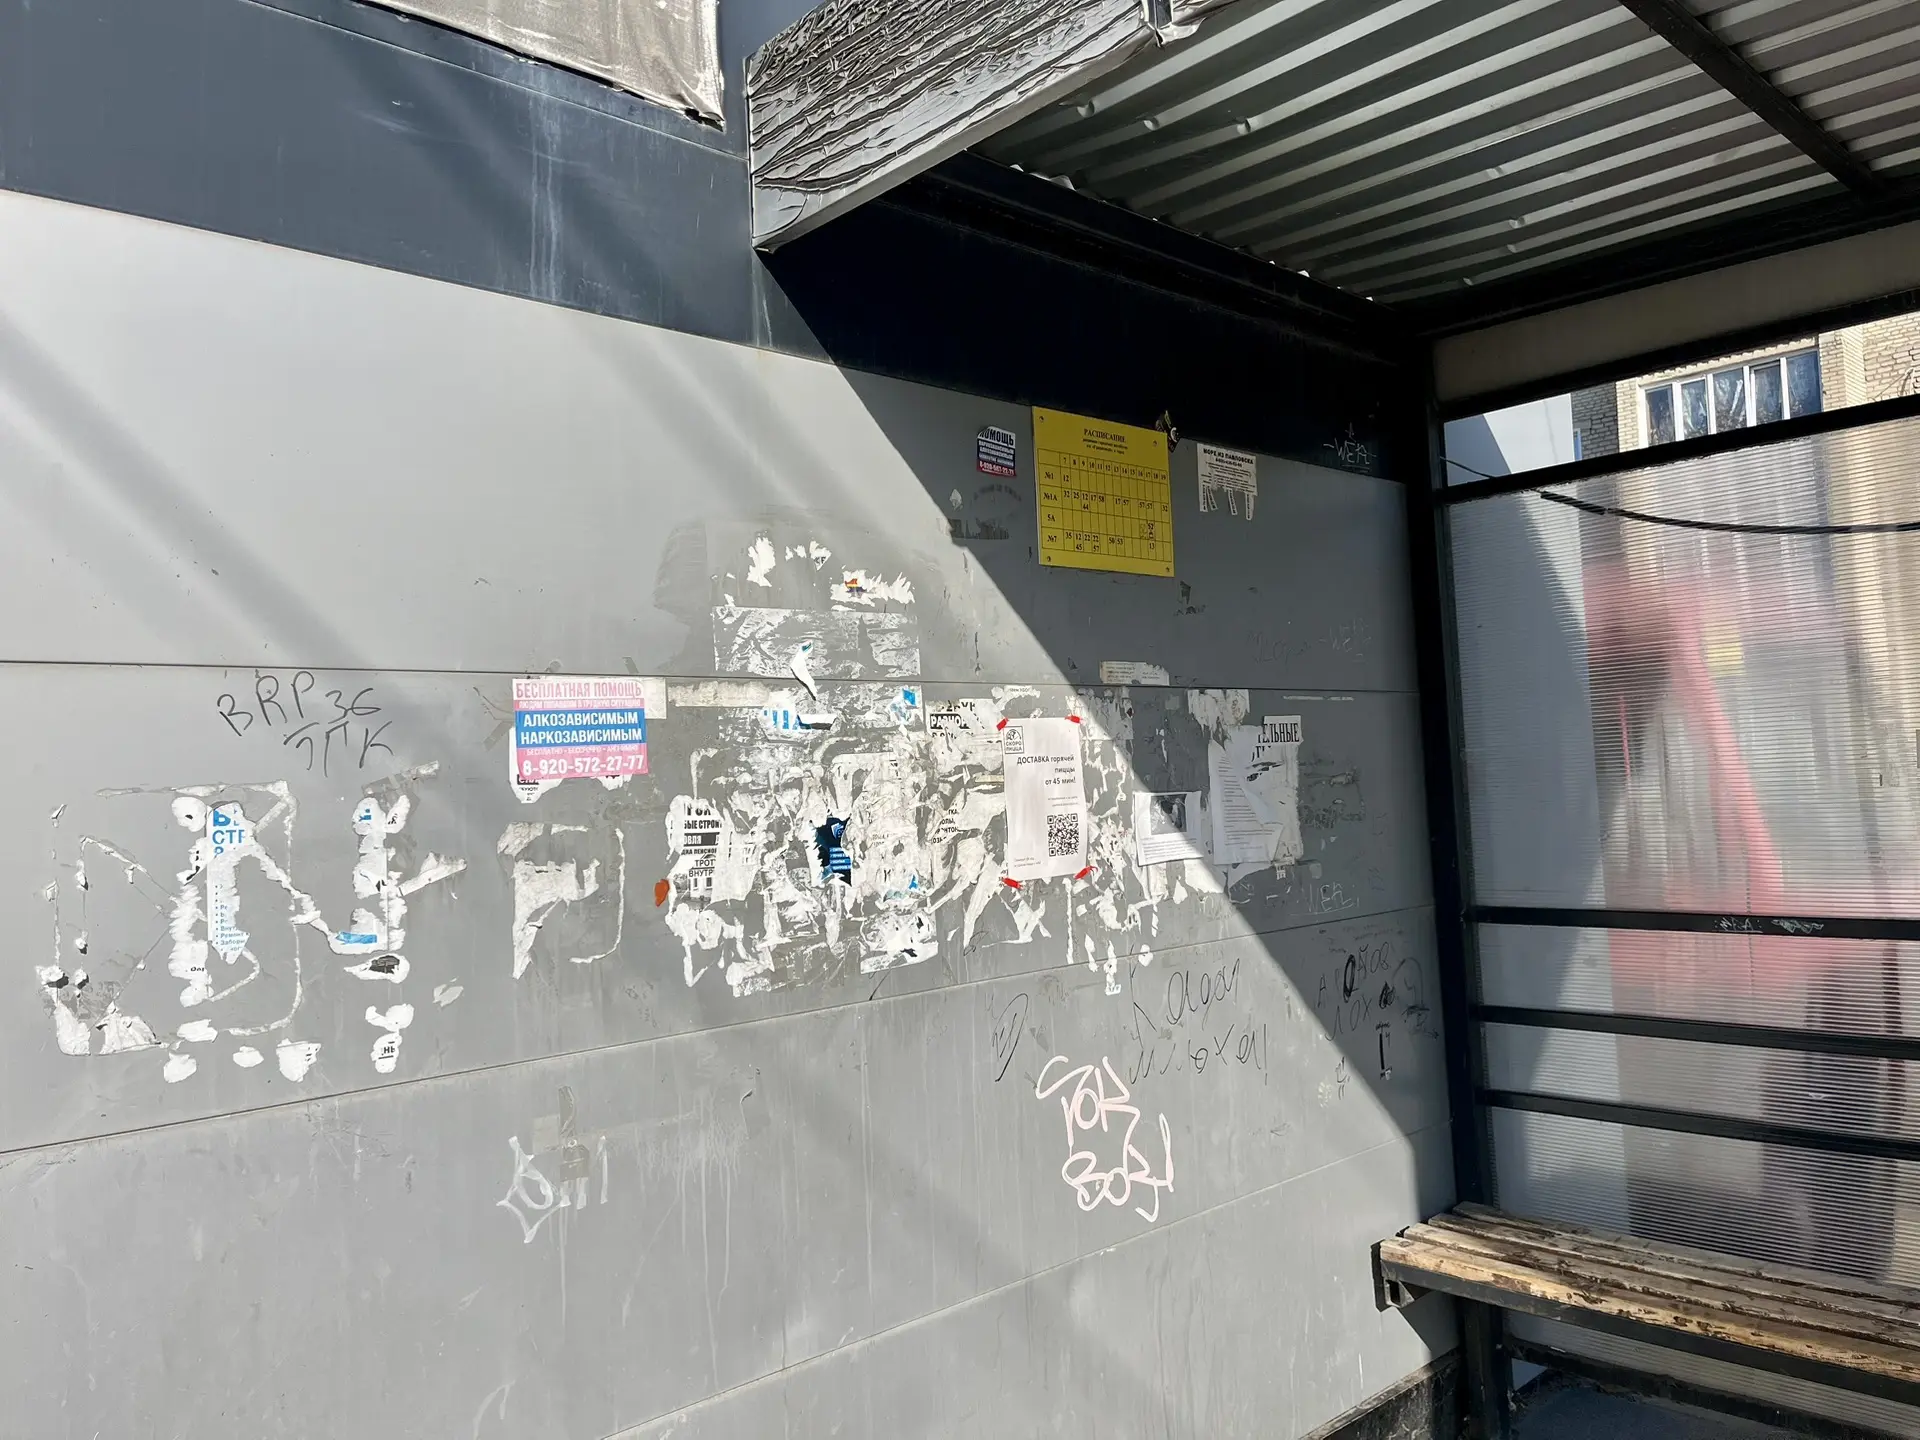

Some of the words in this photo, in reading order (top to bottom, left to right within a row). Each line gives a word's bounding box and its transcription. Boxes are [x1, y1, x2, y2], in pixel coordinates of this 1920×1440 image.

[1082, 493, 1089, 501] 12
[1075, 533, 1082, 541] 12
[516, 682, 591, 699] БЕСПЛАТНАЯ
[594, 681, 642, 699] ПОМОЩЬ
[523, 711, 639, 727] АЛКОЗАВИСИМЫМ
[520, 728, 642, 745] НАРКОЗАВИСИМЫМ
[522, 755, 645, 777] 8-920-572-27-77
[1016, 755, 1050, 766] ДОСТАВКА
